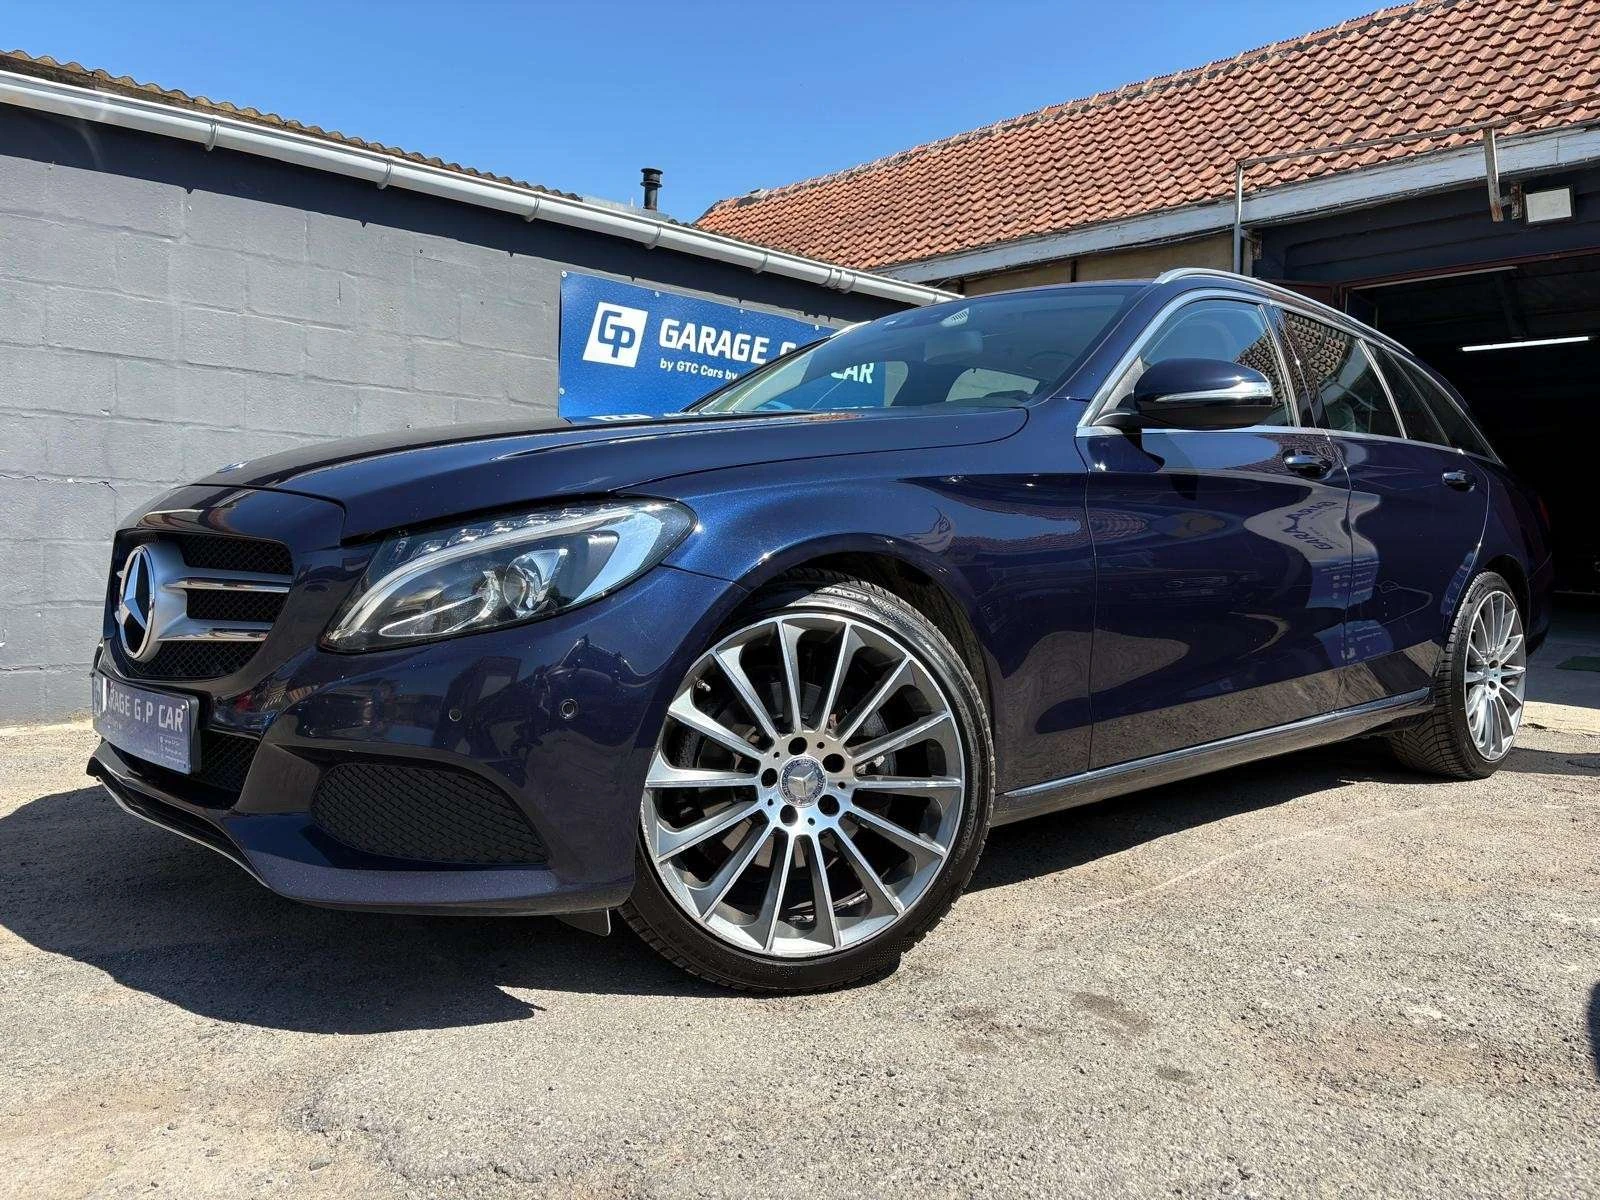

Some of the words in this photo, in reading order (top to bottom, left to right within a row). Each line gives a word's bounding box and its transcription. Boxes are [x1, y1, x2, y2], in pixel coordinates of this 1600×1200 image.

[659, 317, 770, 366] GARAGE
[660, 357, 674, 372] by
[676, 360, 699, 374] GTC
[701, 364, 723, 379] Cars
[725, 368, 738, 380] by
[134, 698, 154, 724] G.P
[158, 704, 184, 733] CAR
